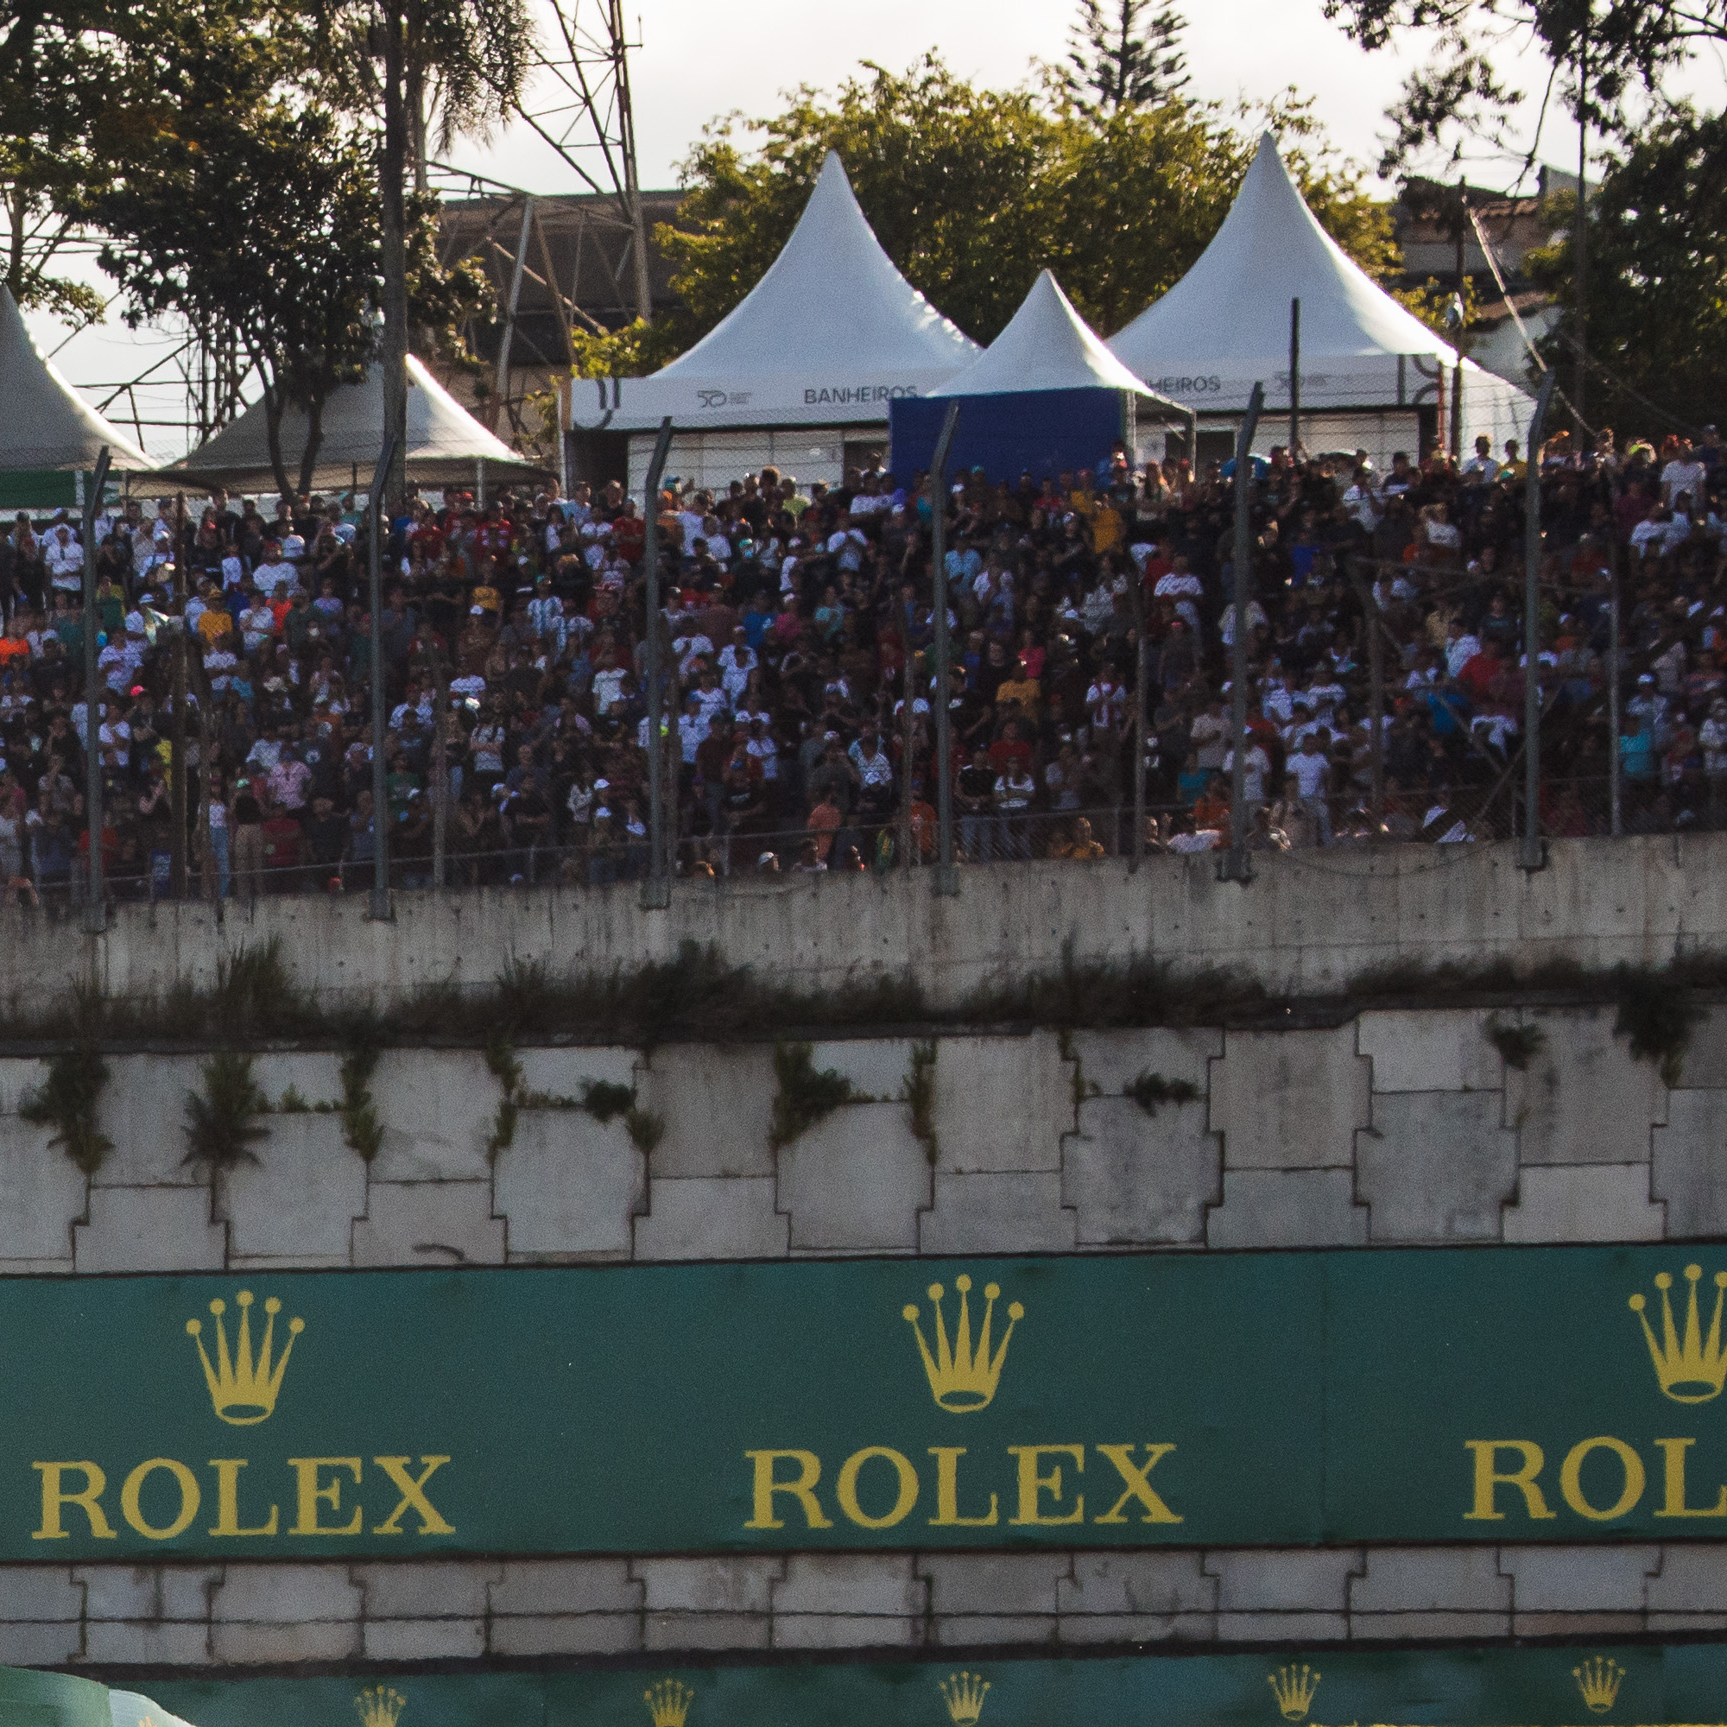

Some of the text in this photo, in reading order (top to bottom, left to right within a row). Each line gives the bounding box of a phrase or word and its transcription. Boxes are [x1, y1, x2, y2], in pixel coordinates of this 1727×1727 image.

[804, 385, 917, 404] BANHEIROS
[32, 1456, 454, 1539] ROLEX
[745, 1444, 1183, 1528] ROLEX
